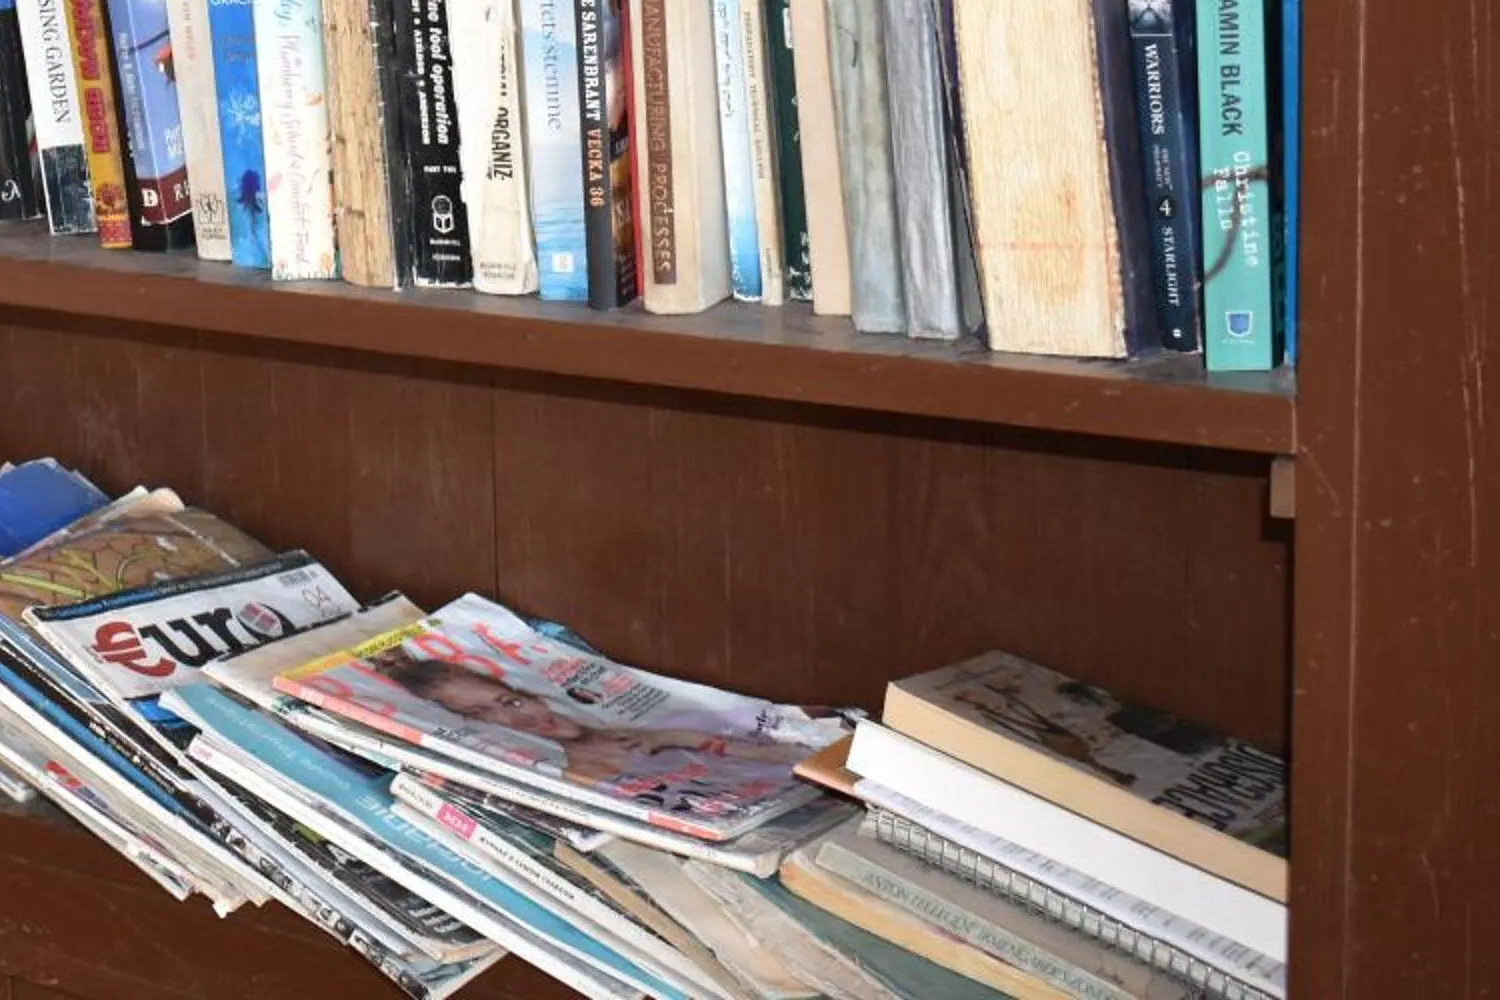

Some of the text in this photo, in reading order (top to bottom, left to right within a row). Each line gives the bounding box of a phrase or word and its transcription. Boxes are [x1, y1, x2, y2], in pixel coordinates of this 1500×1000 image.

[429, 27, 448, 61] tool
[581, 10, 603, 121] SARENBRANT
[45, 45, 72, 125] GARDEN
[418, 90, 431, 146] ANDERSON
[430, 63, 452, 146] operation
[542, 42, 562, 130] stemme
[1144, 43, 1165, 135] WARRIORS
[1220, 64, 1244, 137] BLACK
[587, 127, 604, 182] VECKA
[652, 161, 673, 273] PROCESSES
[1159, 199, 1172, 217] 4
[1213, 167, 1234, 230] Falls
[1233, 151, 1259, 267] Christine
[1161, 226, 1181, 306] STARLIGHT
